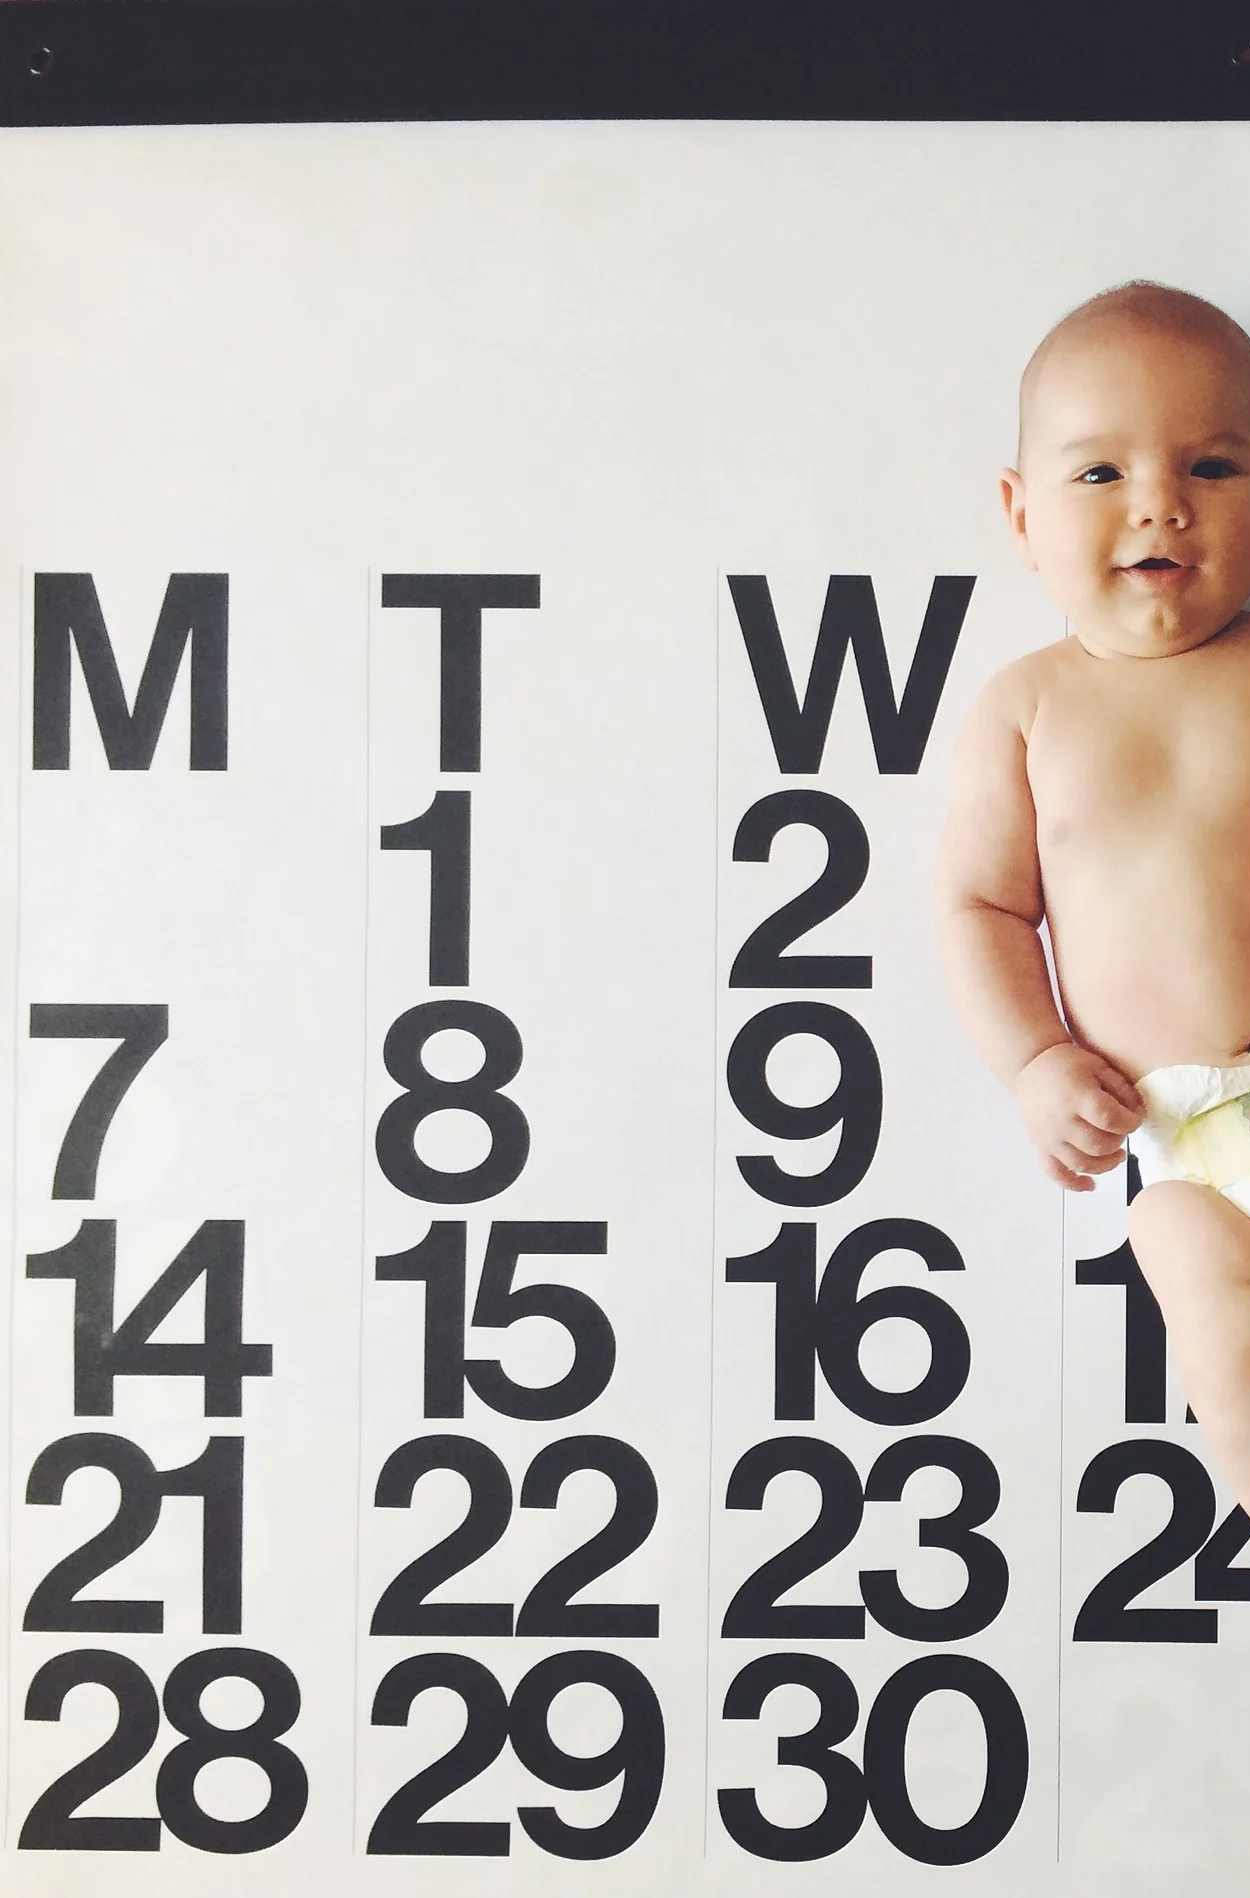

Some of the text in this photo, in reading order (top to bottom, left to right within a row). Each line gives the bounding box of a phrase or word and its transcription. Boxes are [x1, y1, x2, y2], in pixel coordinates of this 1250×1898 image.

[33, 573, 229, 771] M
[381, 574, 541, 773] T
[727, 575, 977, 775] W
[381, 791, 471, 987] 1
[729, 789, 873, 989] 2
[30, 1003, 168, 1200] 7
[376, 1000, 530, 1205] 8
[727, 1002, 883, 1208] 9
[27, 1219, 273, 1418] 14
[376, 1221, 616, 1422] 15
[726, 1218, 971, 1427] 16
[1075, 1237, 1199, 1424] 1
[23, 1433, 245, 1635] 21
[370, 1435, 660, 1638] 22
[721, 1434, 1010, 1643] 23
[18, 1647, 309, 1855] 28
[367, 1650, 666, 1861] 29
[718, 1653, 1029, 1867] 30
